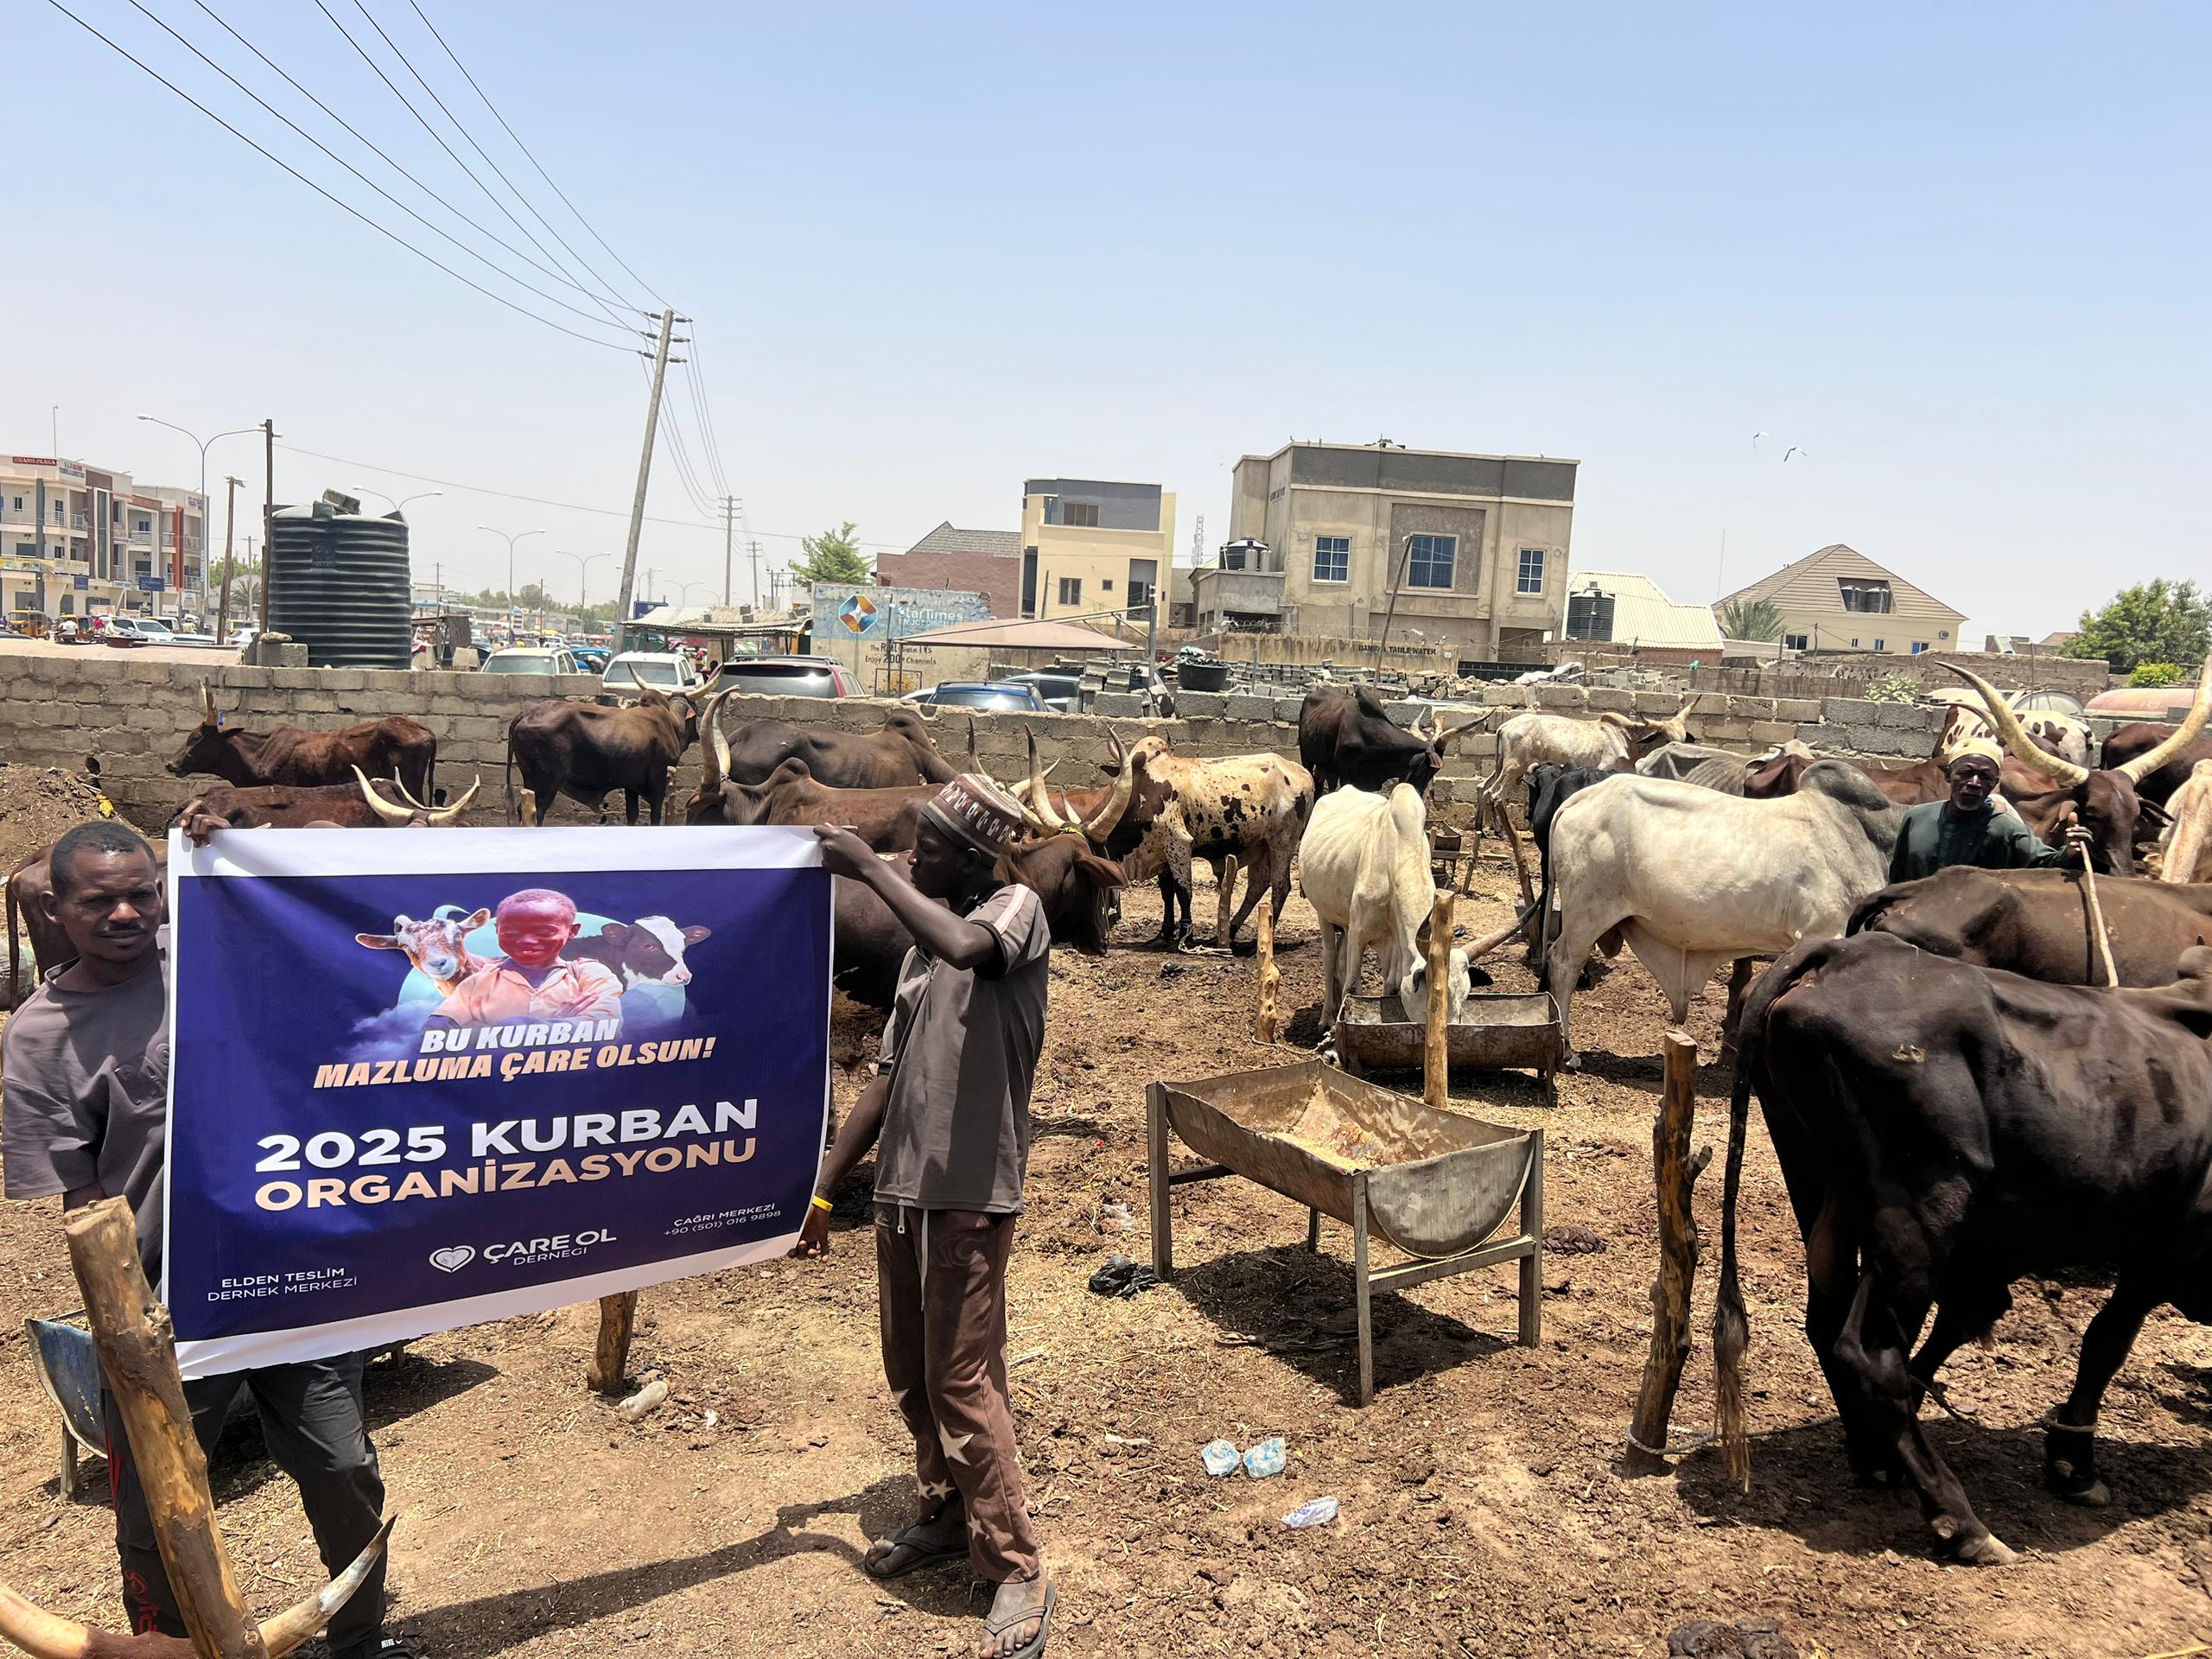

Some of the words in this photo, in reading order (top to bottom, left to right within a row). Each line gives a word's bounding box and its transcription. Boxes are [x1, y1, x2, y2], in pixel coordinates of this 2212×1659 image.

[898, 607, 964, 621] StarTimes
[420, 1027, 472, 1053] BU
[476, 1019, 620, 1050] KURBAN
[313, 1054, 492, 1089] MAZLUMA
[499, 1047, 592, 1082] ÇARE
[596, 1037, 716, 1069] OLSUN!
[255, 1125, 447, 1173] 2025
[472, 1098, 757, 1158] KURBAN
[255, 1137, 757, 1211] ORGANİZASYONU
[664, 1226, 689, 1236] +90
[691, 1220, 722, 1232] (501)
[726, 1216, 747, 1226] 016
[750, 1211, 781, 1222] 9898
[674, 1214, 715, 1227] ÇAĞRI
[483, 1234, 570, 1264] ÇARE
[575, 1228, 617, 1246] OL
[221, 1274, 279, 1288] ELDEN
[284, 1267, 345, 1282] TESLİM
[207, 1286, 279, 1301] DERNEK
